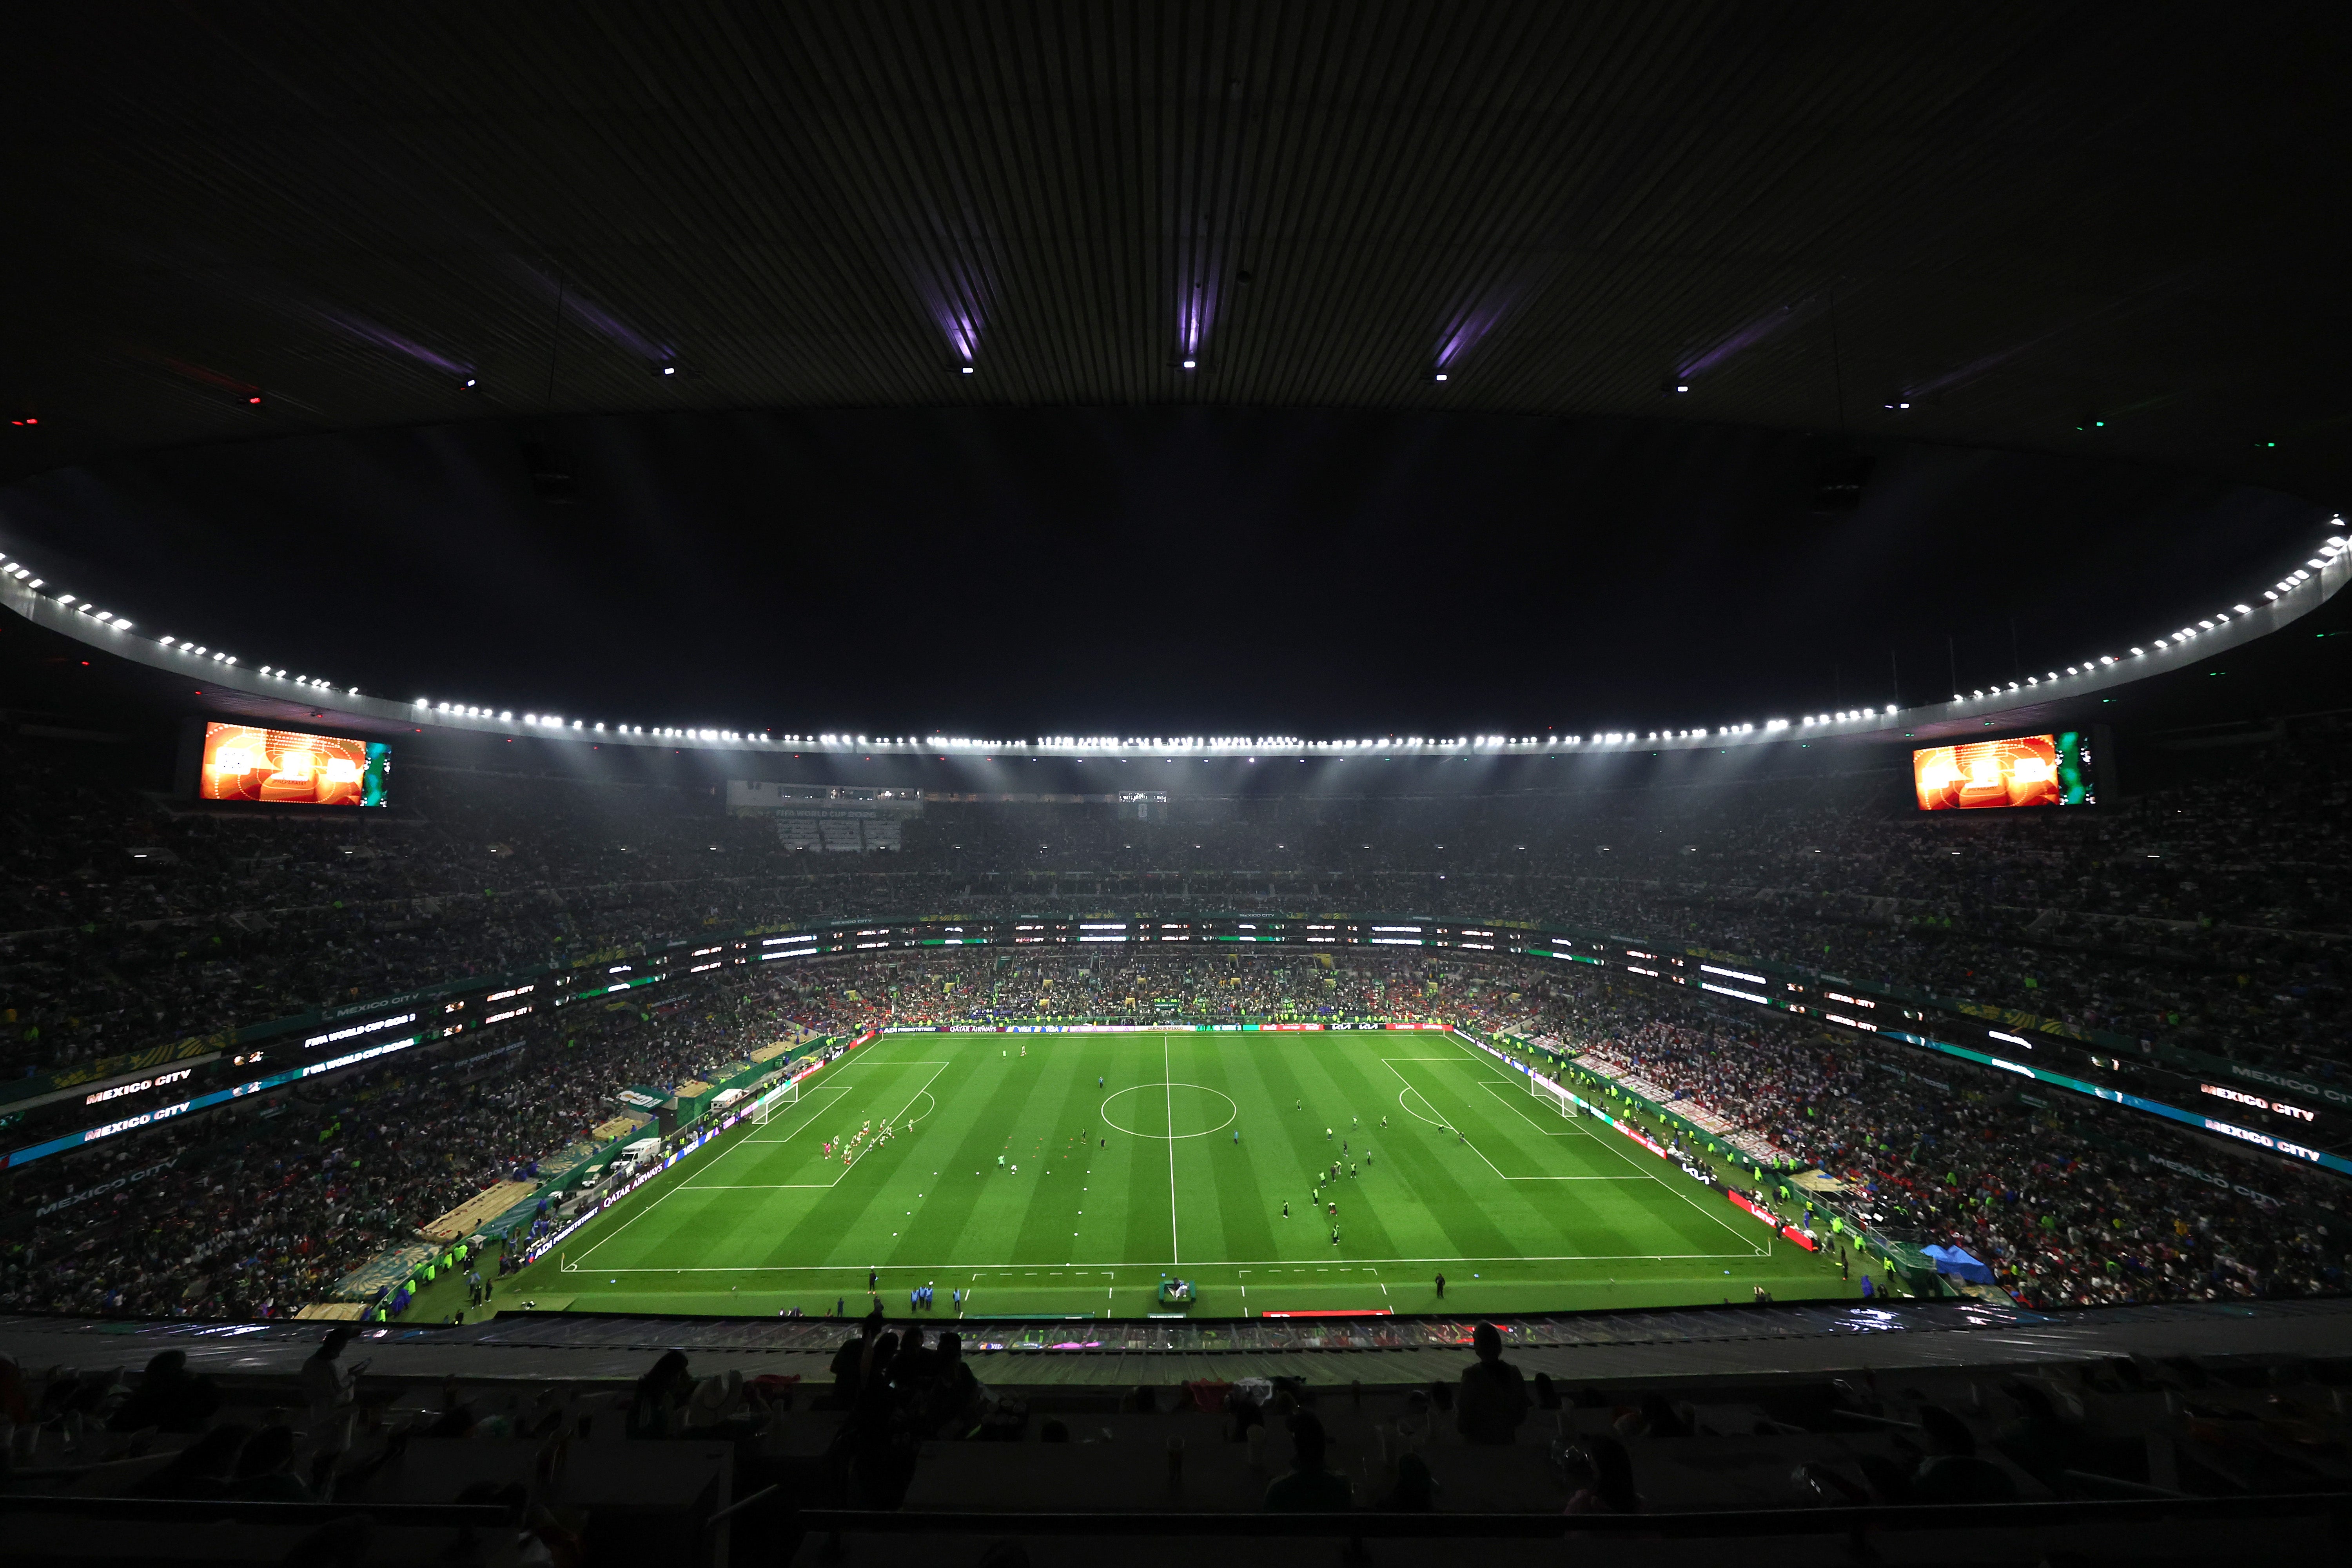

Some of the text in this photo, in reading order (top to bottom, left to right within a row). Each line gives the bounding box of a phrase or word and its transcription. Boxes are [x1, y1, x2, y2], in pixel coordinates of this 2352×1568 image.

[337, 993, 419, 1017] MEXICO CITY
[86, 1069, 192, 1105] MEXICO CITY
[2200, 1083, 2314, 1122] MEXICO CITY
[2232, 1065, 2352, 1103] MEXICO CI
[84, 1102, 191, 1142] MEXICO CITY
[2205, 1119, 2320, 1162] MEXICO CITY
[682, 1139, 699, 1156] VISA
[36, 1158, 178, 1217] MEXICO CITY
[603, 1163, 663, 1208] QATAR AIRWAYS
[2148, 1153, 2229, 1189] MEXICO
[534, 1206, 599, 1259] ADI PREDICTSTREET
